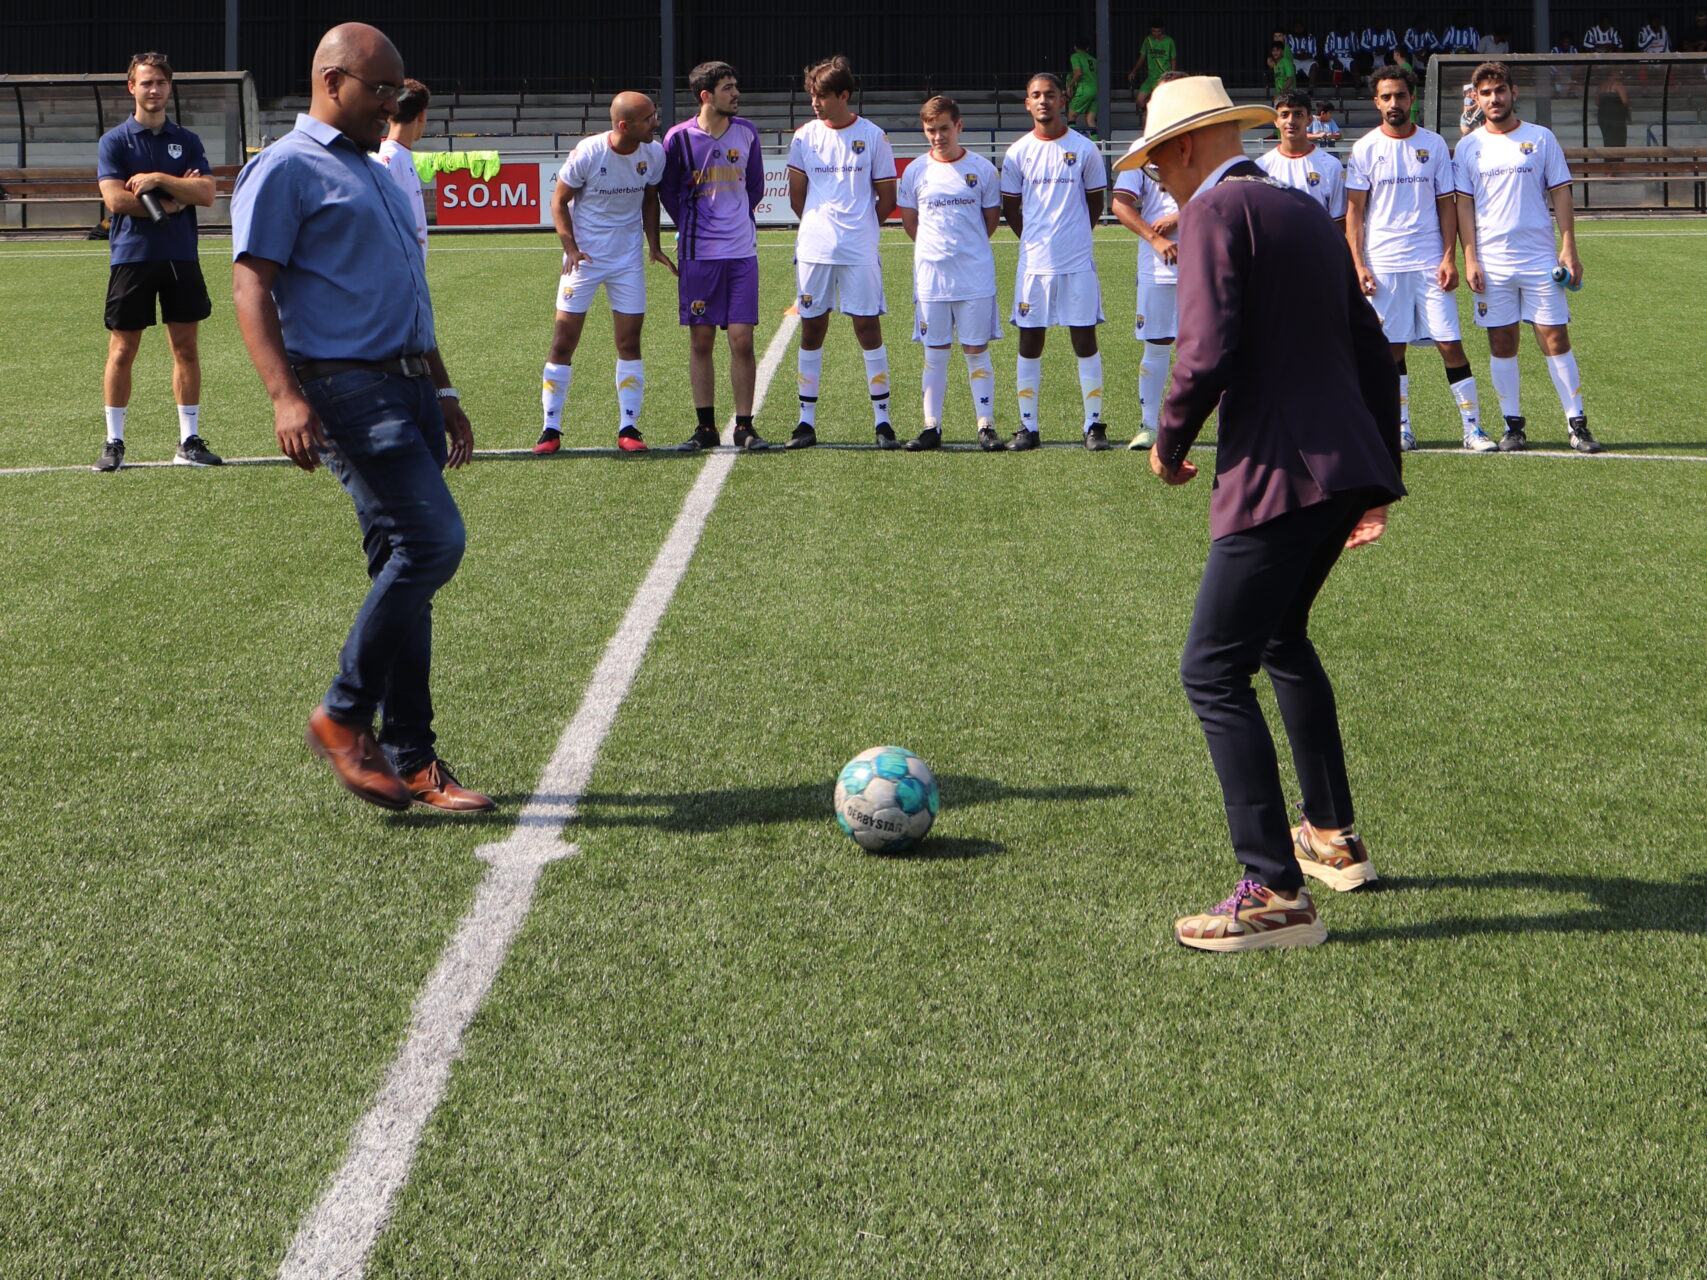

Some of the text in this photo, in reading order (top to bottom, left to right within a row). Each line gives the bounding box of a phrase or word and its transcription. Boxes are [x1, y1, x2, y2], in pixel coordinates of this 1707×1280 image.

[1479, 165, 1533, 177] mulderblauw
[442, 182, 537, 209] S.O.M.
[847, 806, 902, 833] DERBYSTAR
